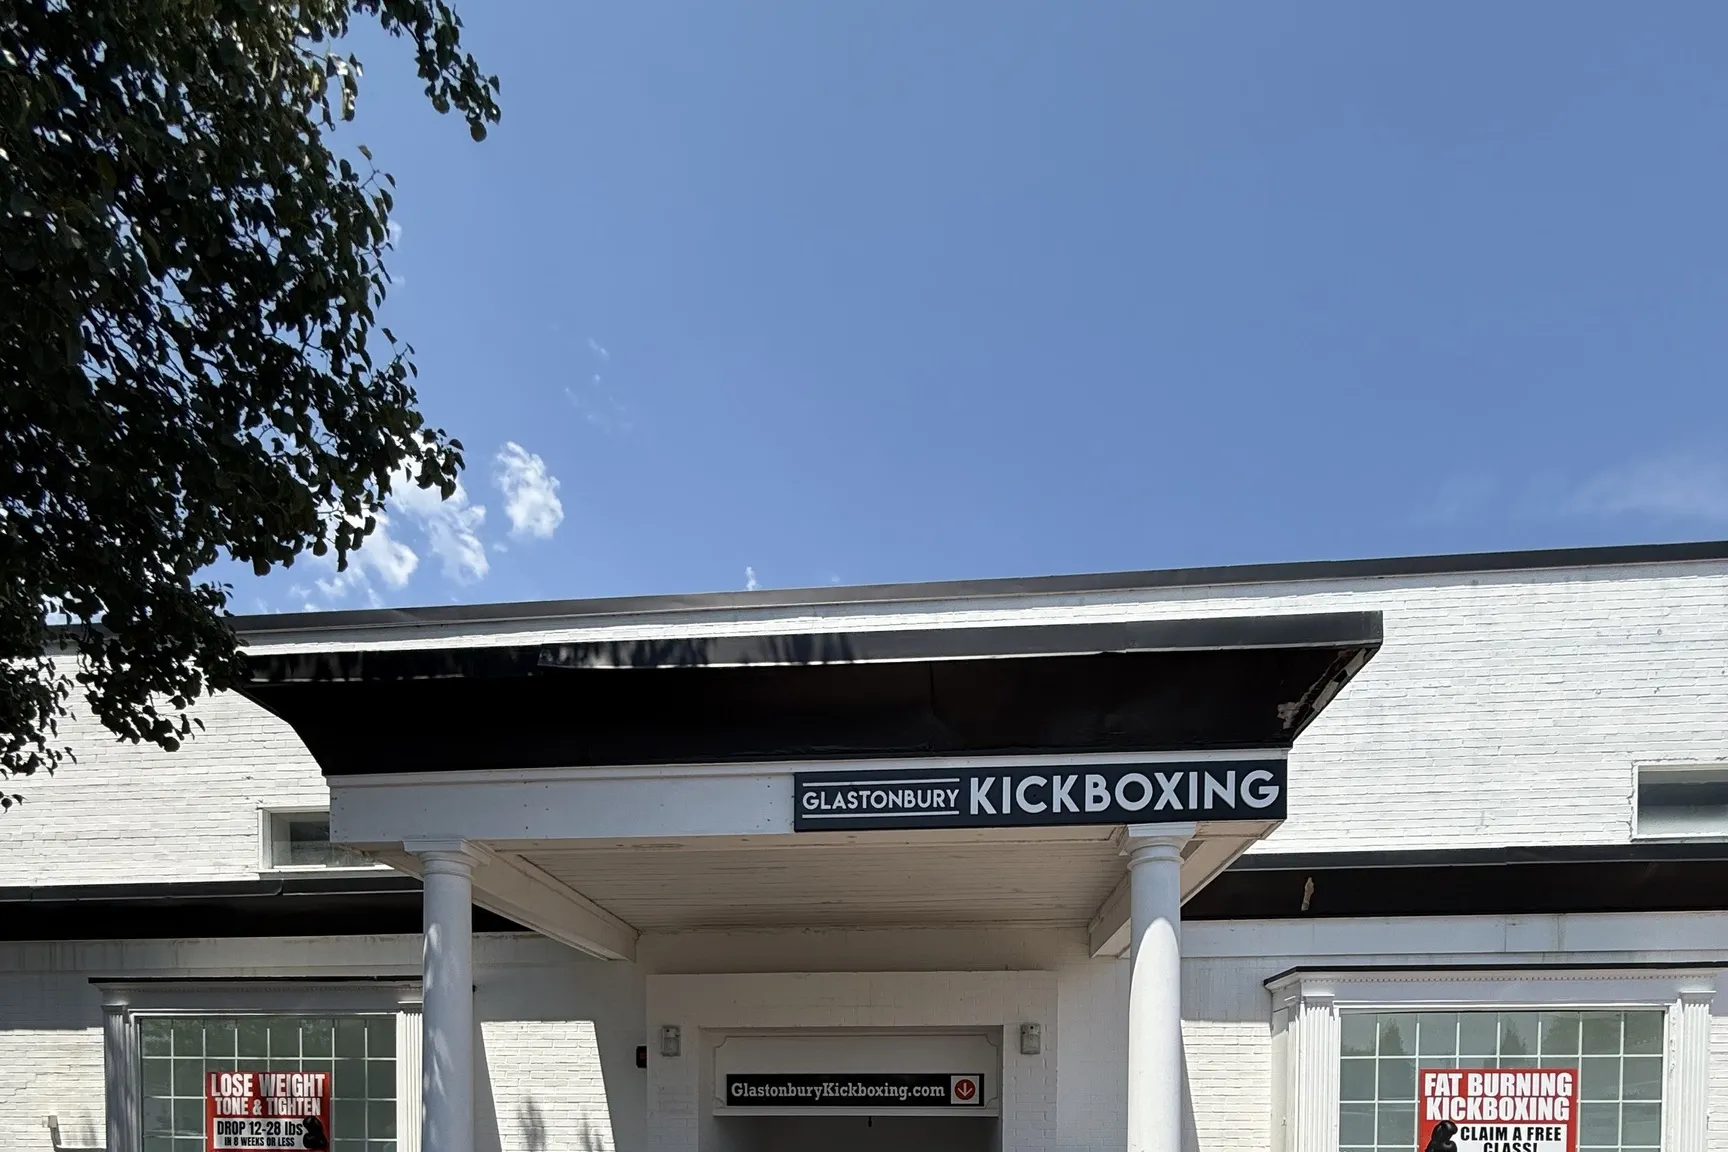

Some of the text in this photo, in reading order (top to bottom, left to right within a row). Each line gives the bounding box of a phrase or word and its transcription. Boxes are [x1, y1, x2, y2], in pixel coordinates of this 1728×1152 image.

[803, 770, 1280, 815] GLASTONBURY KICKBOXING
[211, 1073, 325, 1097] LOSE WEIGHT
[731, 1082, 945, 1101] GlastonburyKickboxing.com
[1424, 1072, 1573, 1097] FAT BURNING
[214, 1097, 321, 1116] TONE & TIGHTEN
[1426, 1097, 1570, 1121] KICKBOXING
[217, 1121, 303, 1136] DROP 12-28 lbs
[1460, 1126, 1562, 1141] CLAIM A FREE
[224, 1137, 295, 1147] IN 8 WEEKS OR LESS
